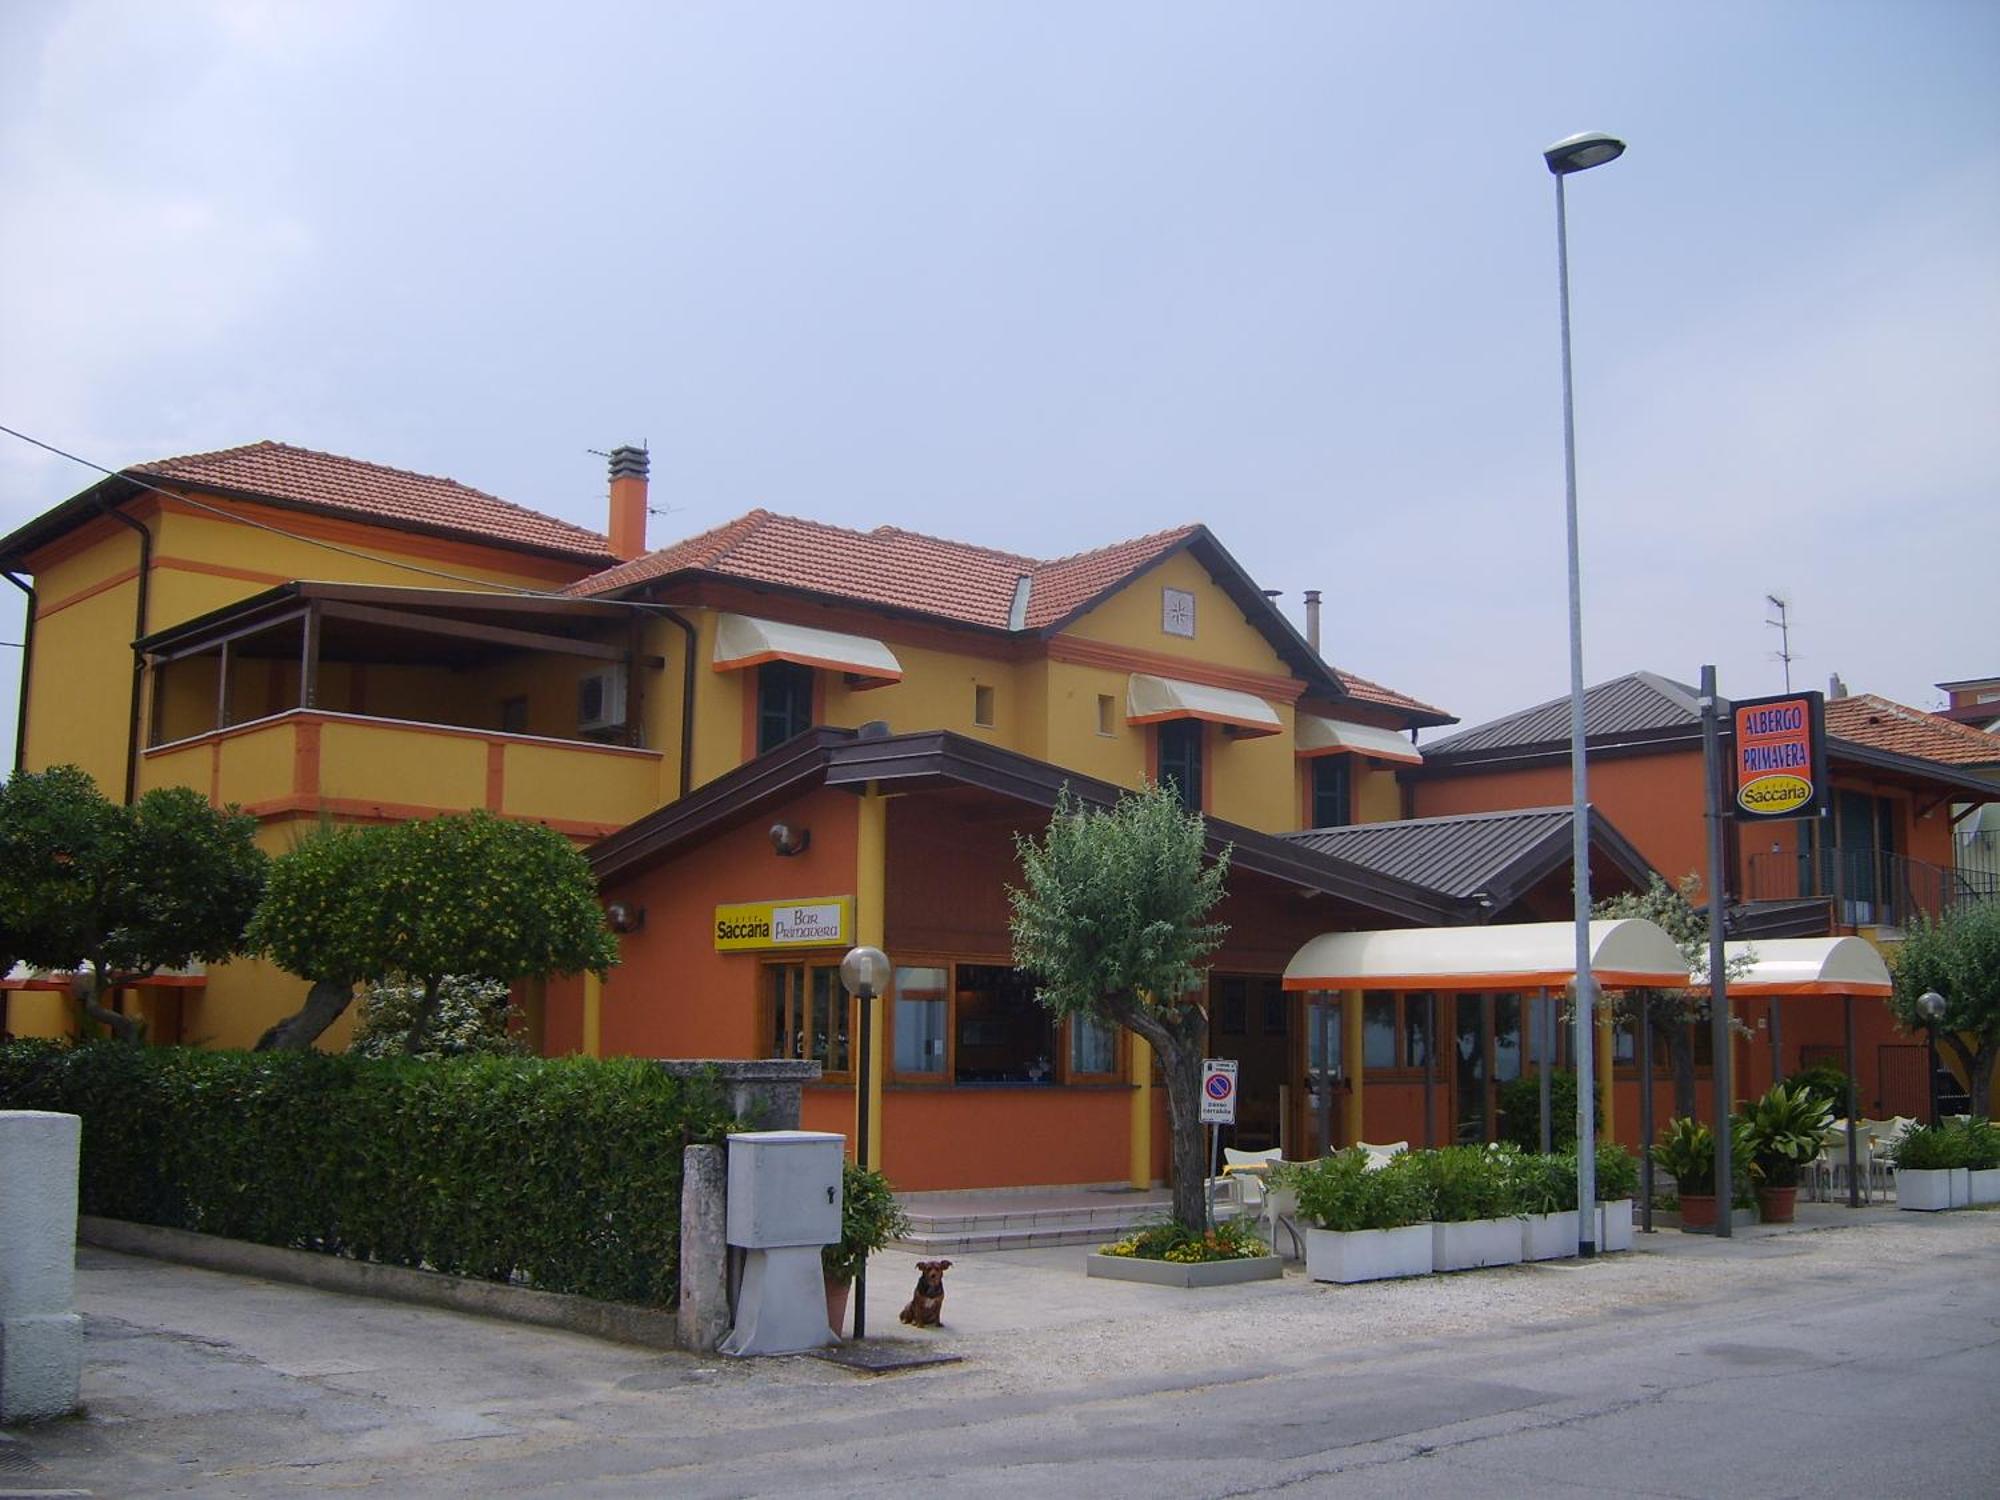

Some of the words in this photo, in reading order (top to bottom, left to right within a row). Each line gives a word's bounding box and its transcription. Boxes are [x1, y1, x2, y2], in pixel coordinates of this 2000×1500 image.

[1746, 707, 1801, 734] ALBERGO
[1744, 743, 1806, 771] PRIMAVERA
[1744, 785, 1806, 804] Saccaria
[775, 922, 838, 939] Primavera
